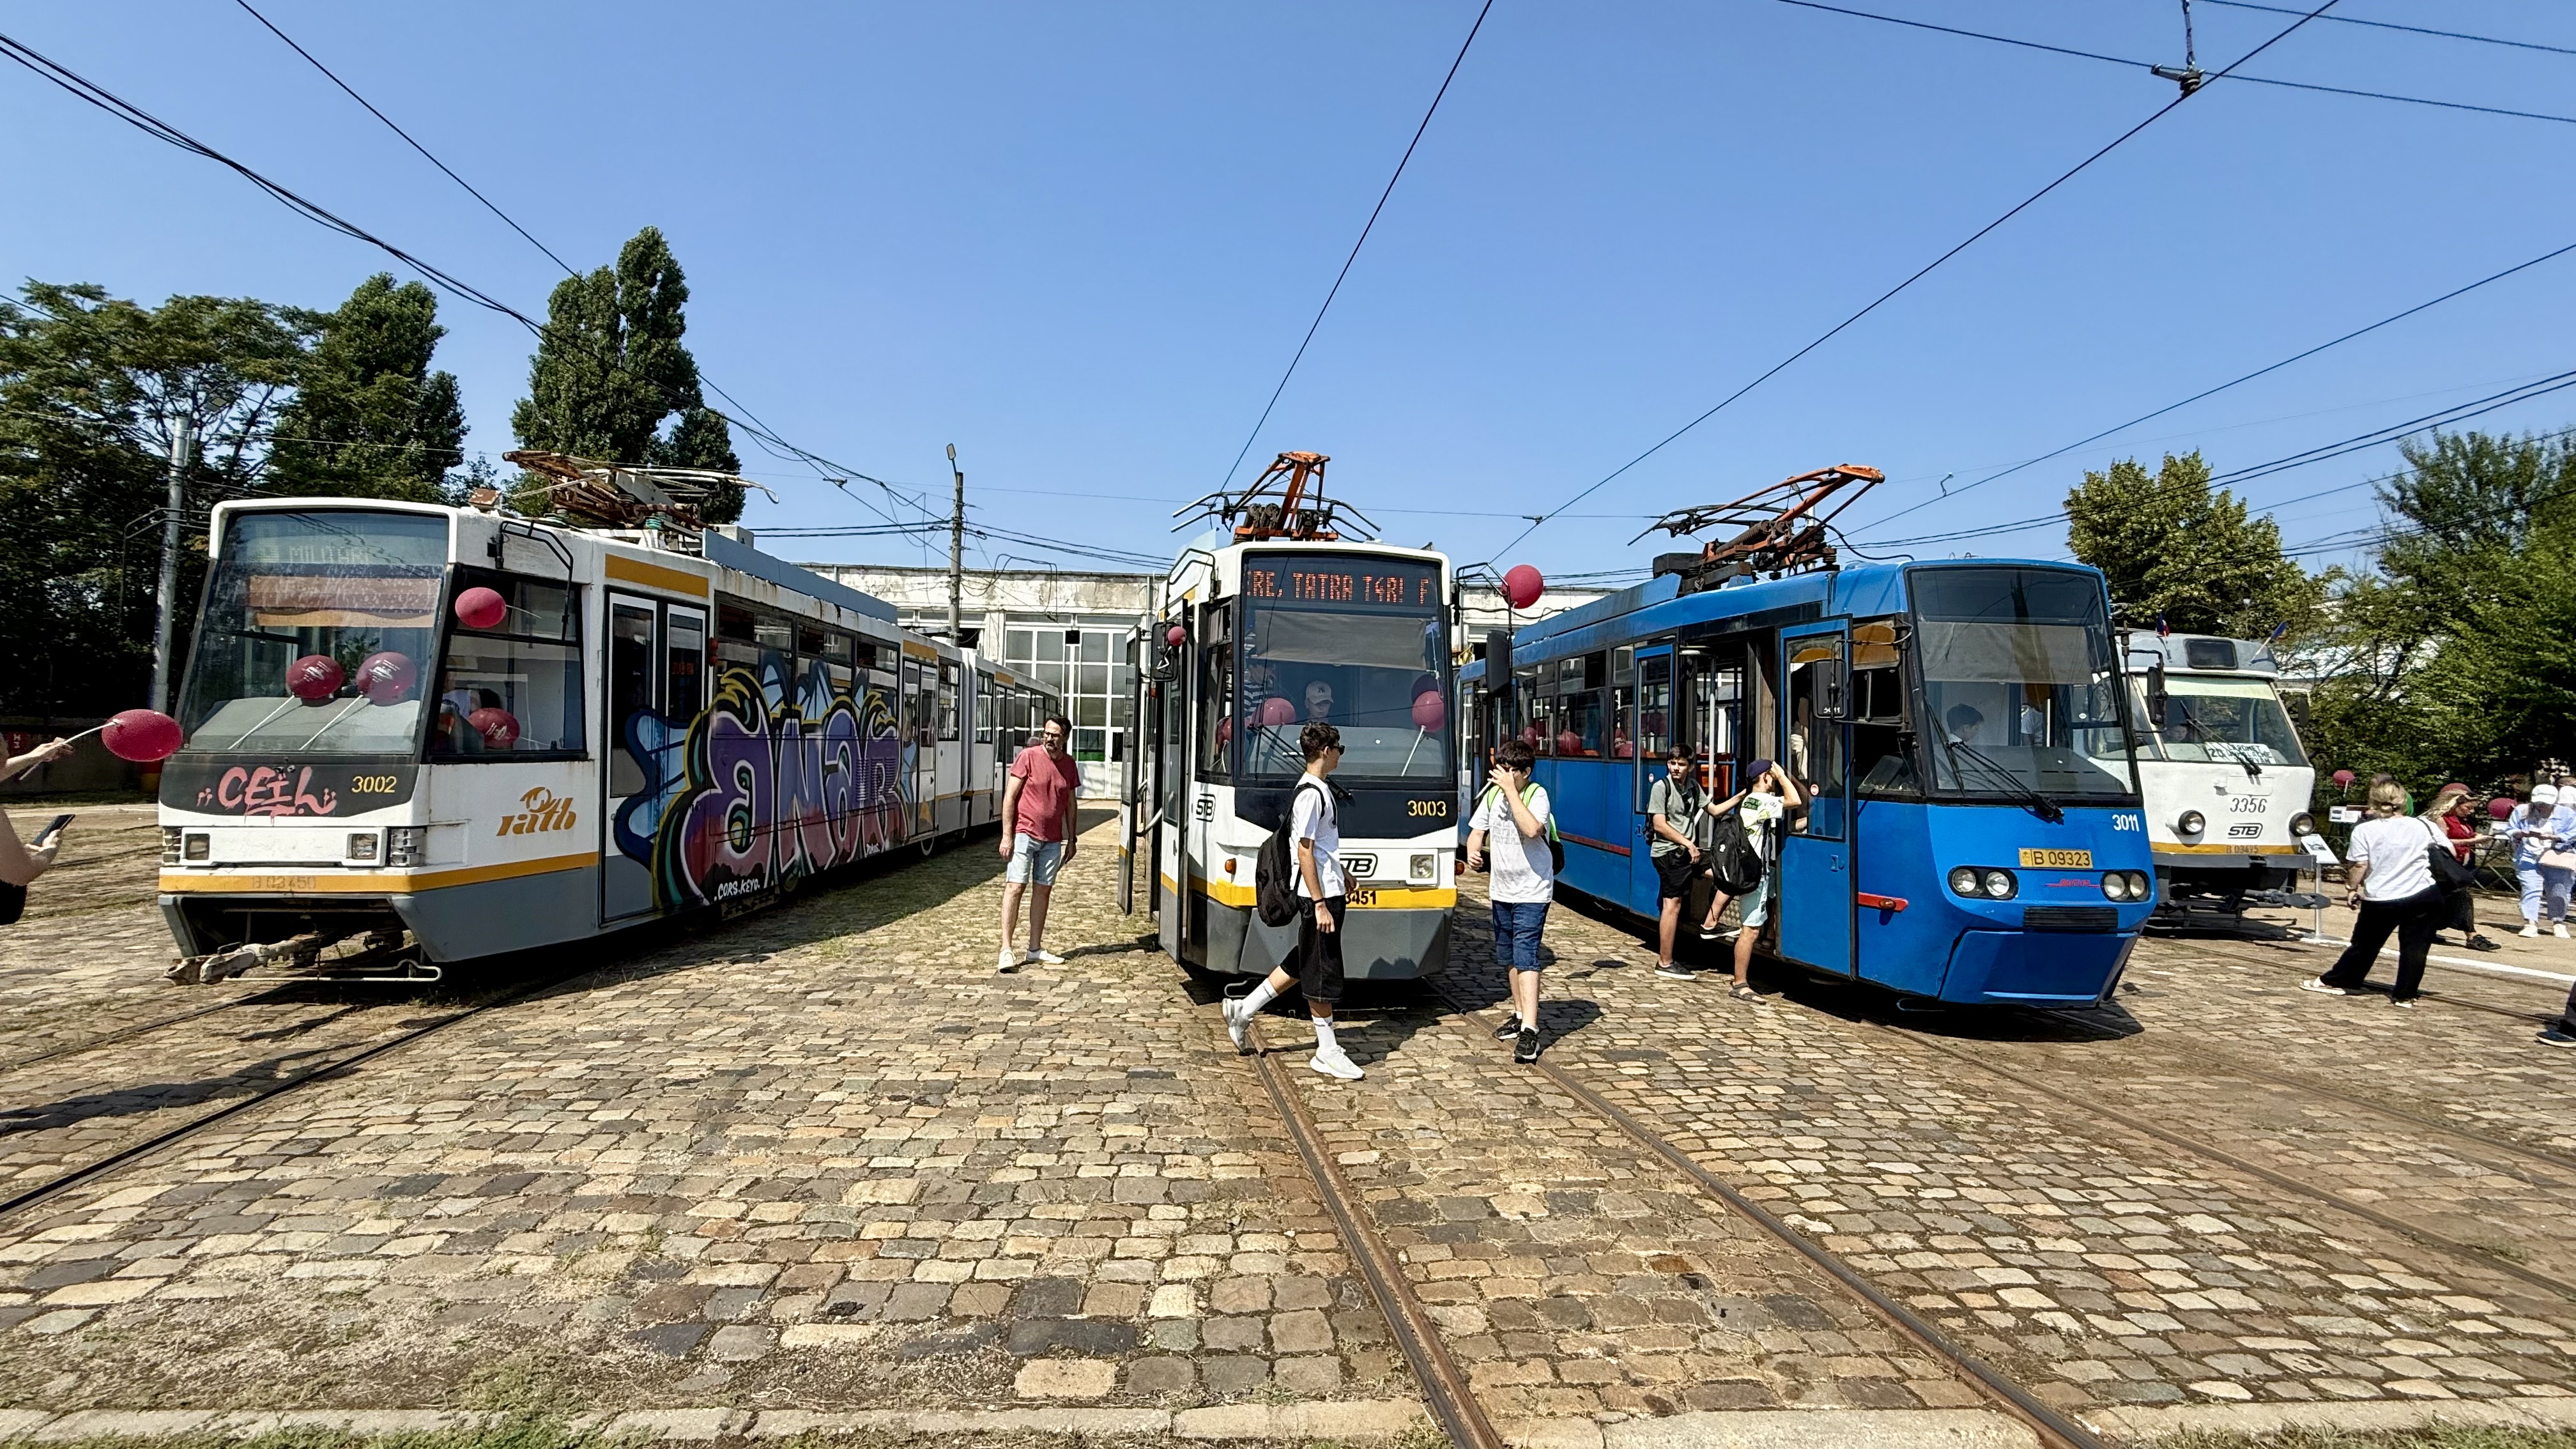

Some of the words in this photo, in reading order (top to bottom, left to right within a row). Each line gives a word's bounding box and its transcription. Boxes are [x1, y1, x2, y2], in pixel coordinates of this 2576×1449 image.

[1292, 572, 1354, 601] TATRA
[351, 775, 397, 793] 3002
[1195, 799, 1214, 816] STB
[1407, 800, 1447, 817] 3003
[2229, 797, 2268, 813] 3356
[2112, 814, 2140, 832] 3011
[2227, 826, 2260, 836] STB
[1339, 858, 1373, 873] TB
[2032, 851, 2045, 866] B
[2048, 851, 2091, 867] 09323
